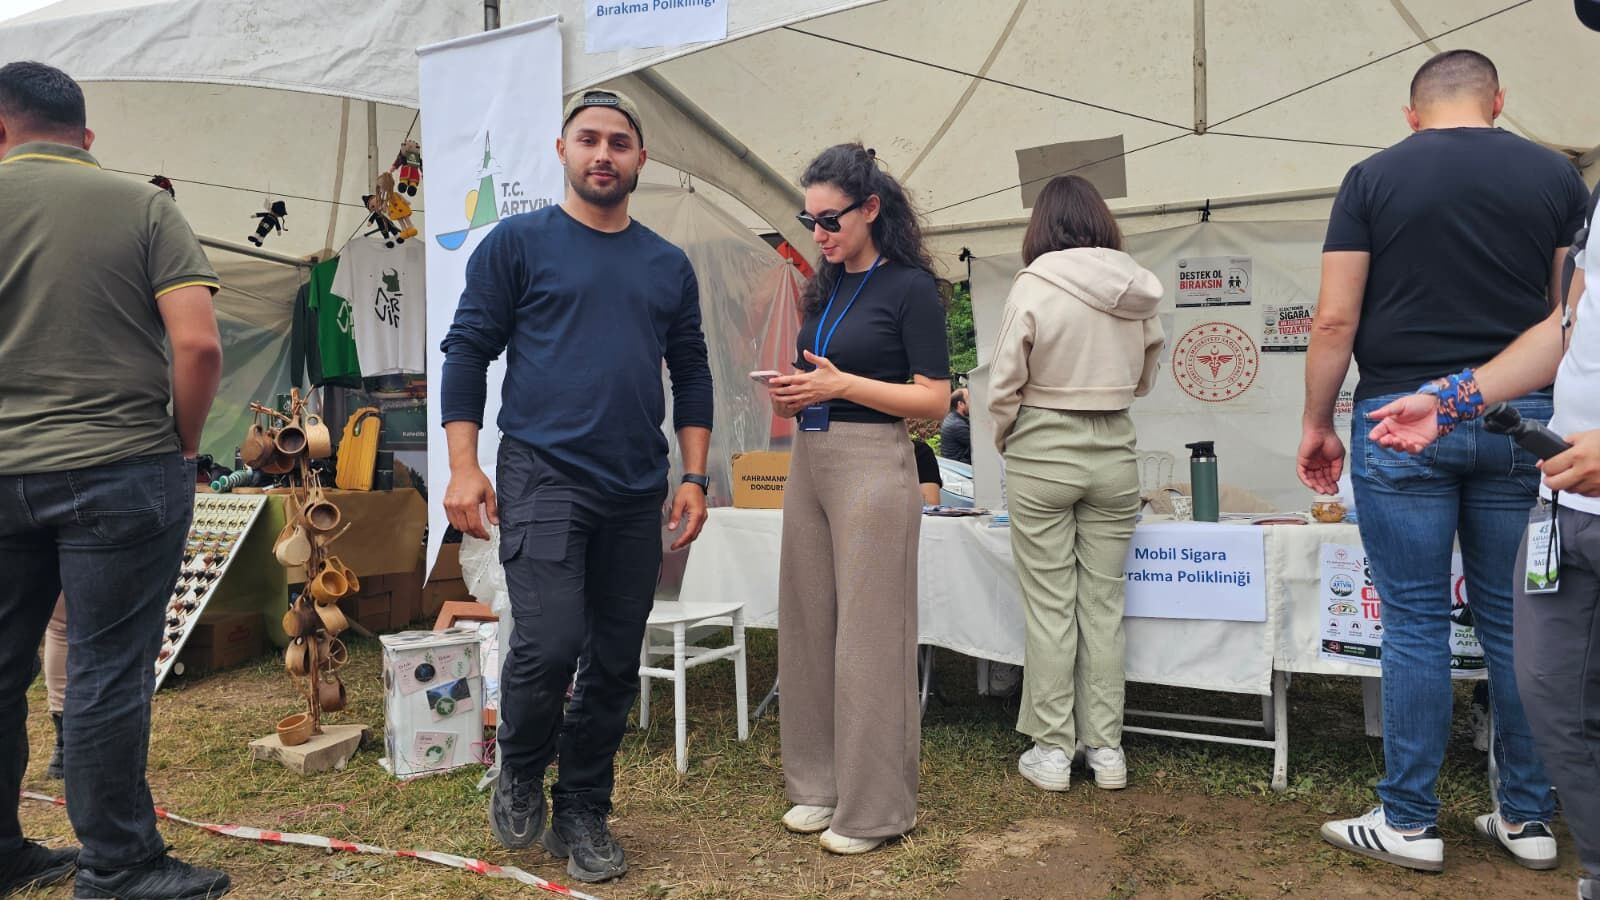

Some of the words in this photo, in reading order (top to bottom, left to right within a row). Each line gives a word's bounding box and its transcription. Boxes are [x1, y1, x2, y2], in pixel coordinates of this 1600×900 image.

[596, 2, 649, 17] Bırakma
[501, 181, 524, 197] T.C.
[1180, 271, 1211, 280] DESTEK
[1212, 269, 1223, 279] OL
[1180, 279, 1223, 290] BIRAKSIN
[1279, 309, 1311, 321] SİGARA
[1134, 548, 1177, 561] Mobil
[1180, 548, 1227, 564] Sigara
[1125, 569, 1173, 582] rakma
[1177, 570, 1251, 587] Polikliniği
